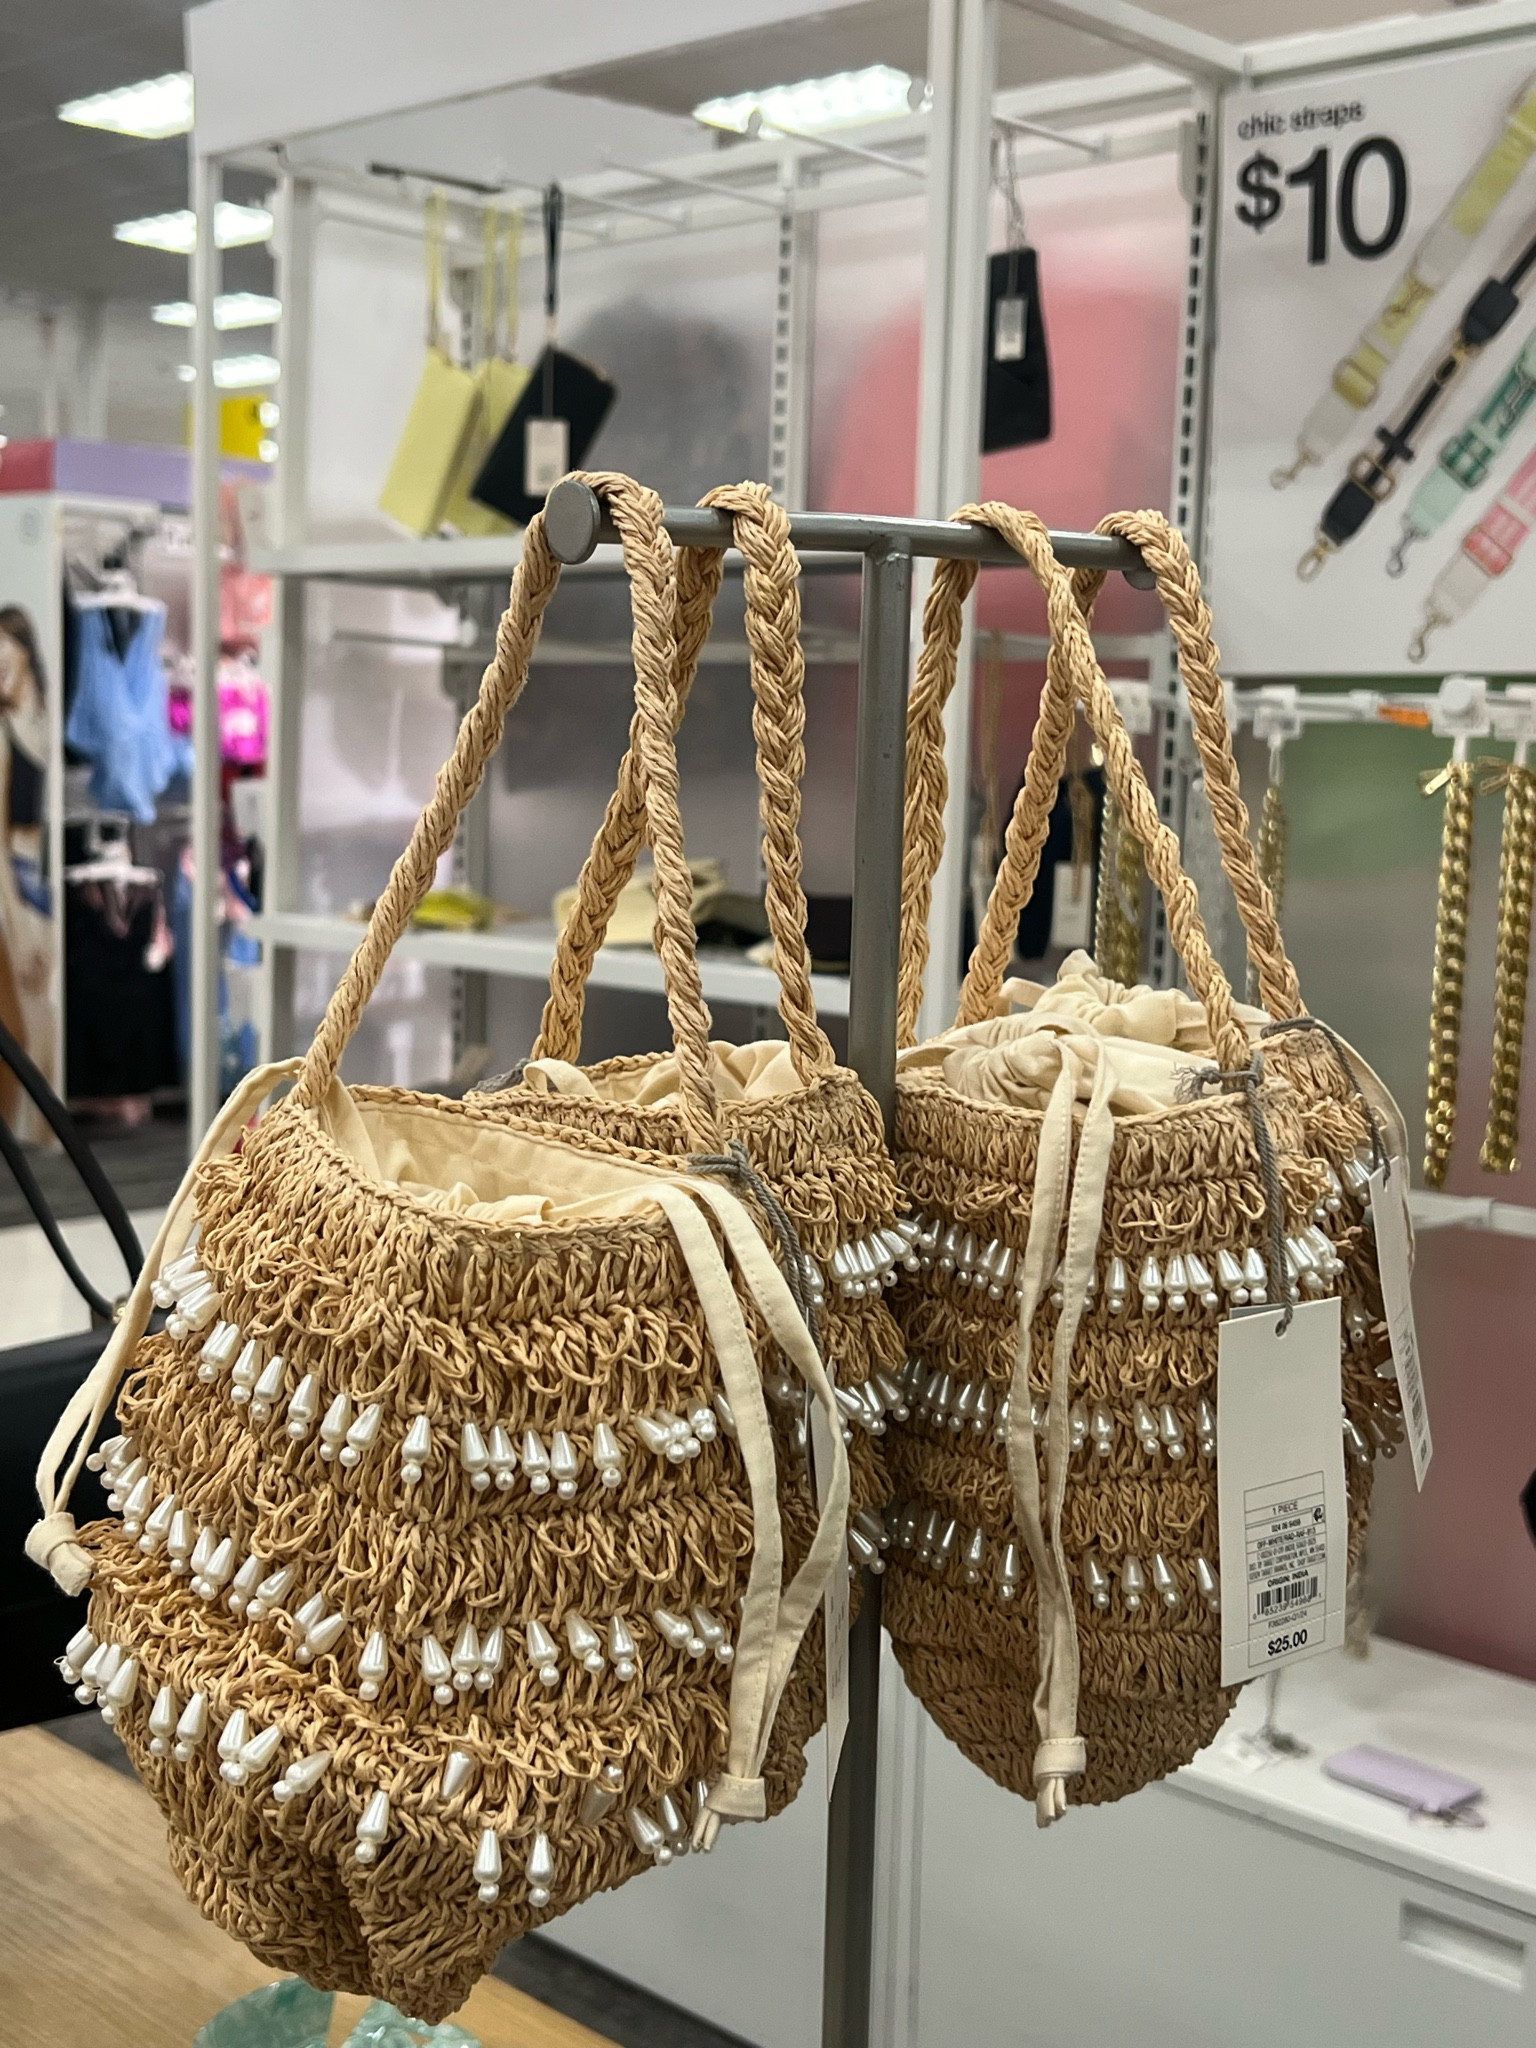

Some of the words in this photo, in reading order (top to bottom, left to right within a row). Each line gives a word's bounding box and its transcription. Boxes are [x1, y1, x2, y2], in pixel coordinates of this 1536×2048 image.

[1238, 112, 1286, 139] chic
[1290, 102, 1364, 130] straps
[1236, 134, 1410, 265] $10
[1278, 1501, 1298, 1513] PIECE
[1267, 1628, 1308, 1656] $25.00
